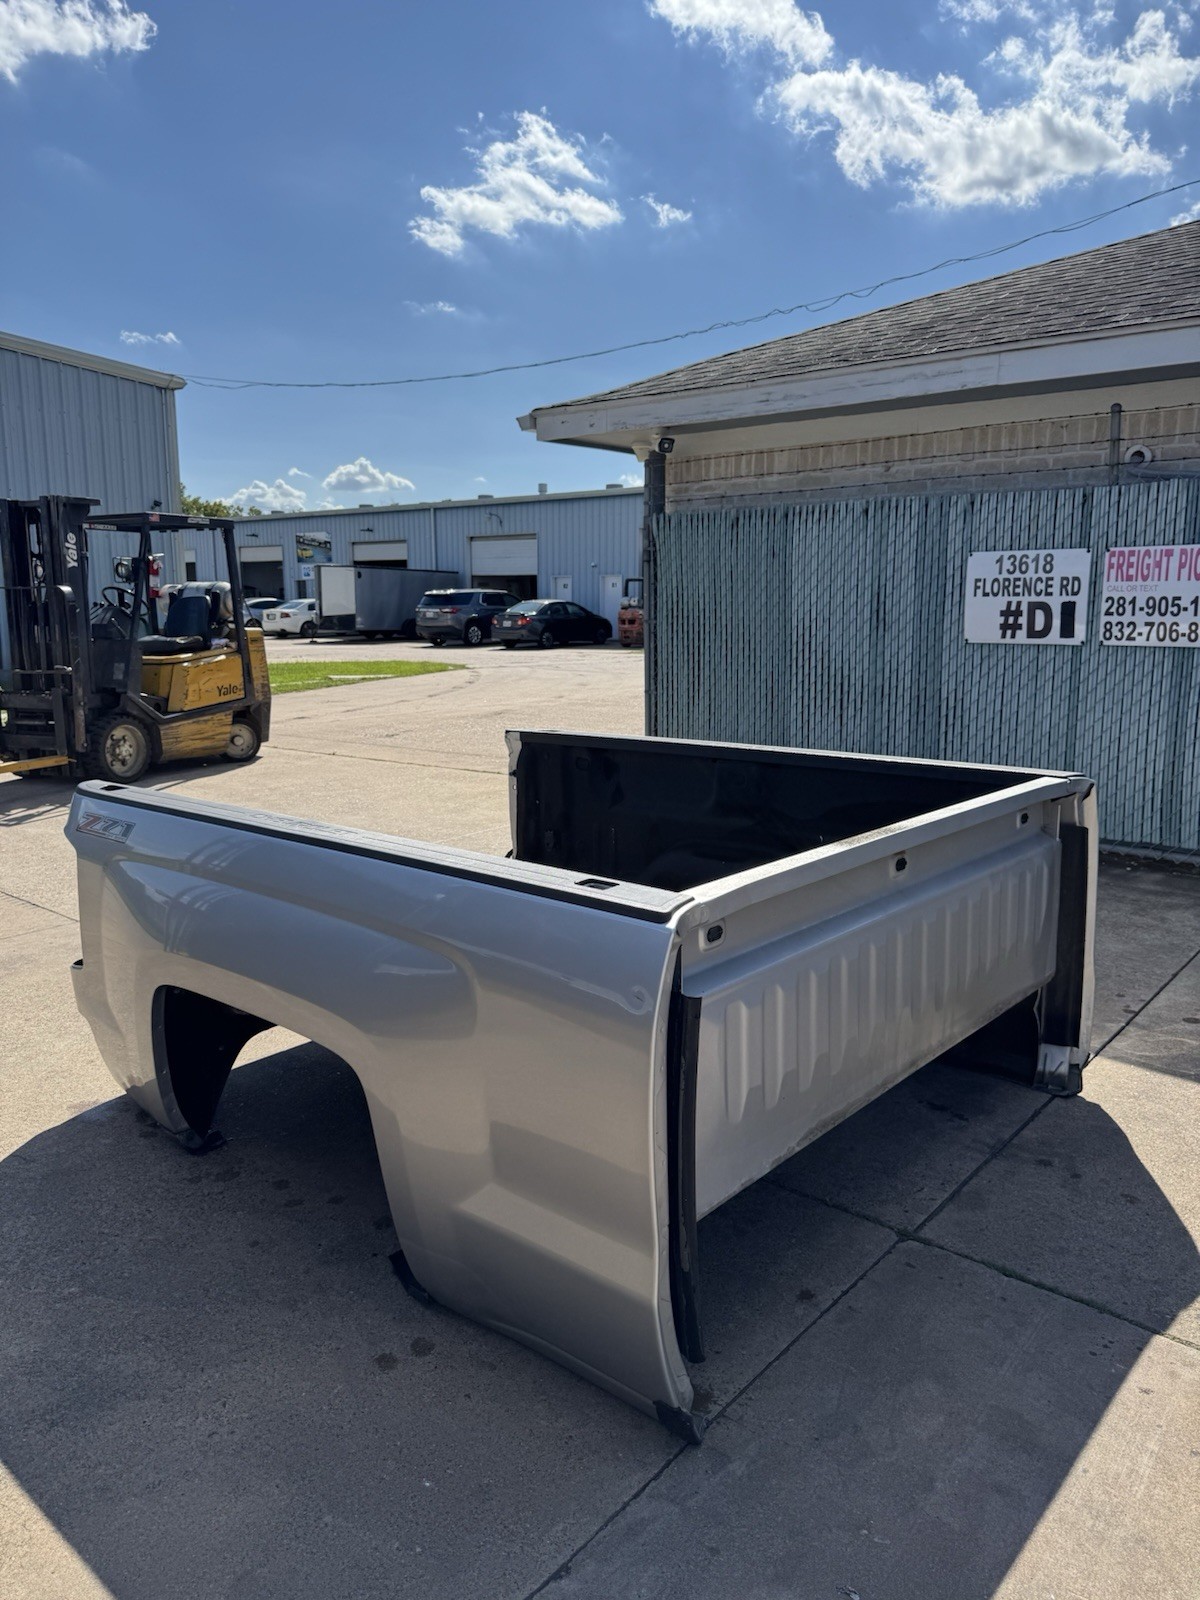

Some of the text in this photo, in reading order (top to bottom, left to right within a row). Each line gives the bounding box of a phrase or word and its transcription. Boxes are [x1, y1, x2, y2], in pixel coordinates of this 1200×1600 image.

[65, 532, 79, 568] Yale
[995, 553, 1054, 575] 13618
[1106, 548, 1174, 582] FREIGHT
[973, 576, 1081, 597] FLORENCE RD
[1104, 595, 1199, 617] 281-905-1
[1103, 621, 1199, 643] 832-706-8
[217, 684, 239, 697] Yale
[77, 812, 136, 842] Z71
